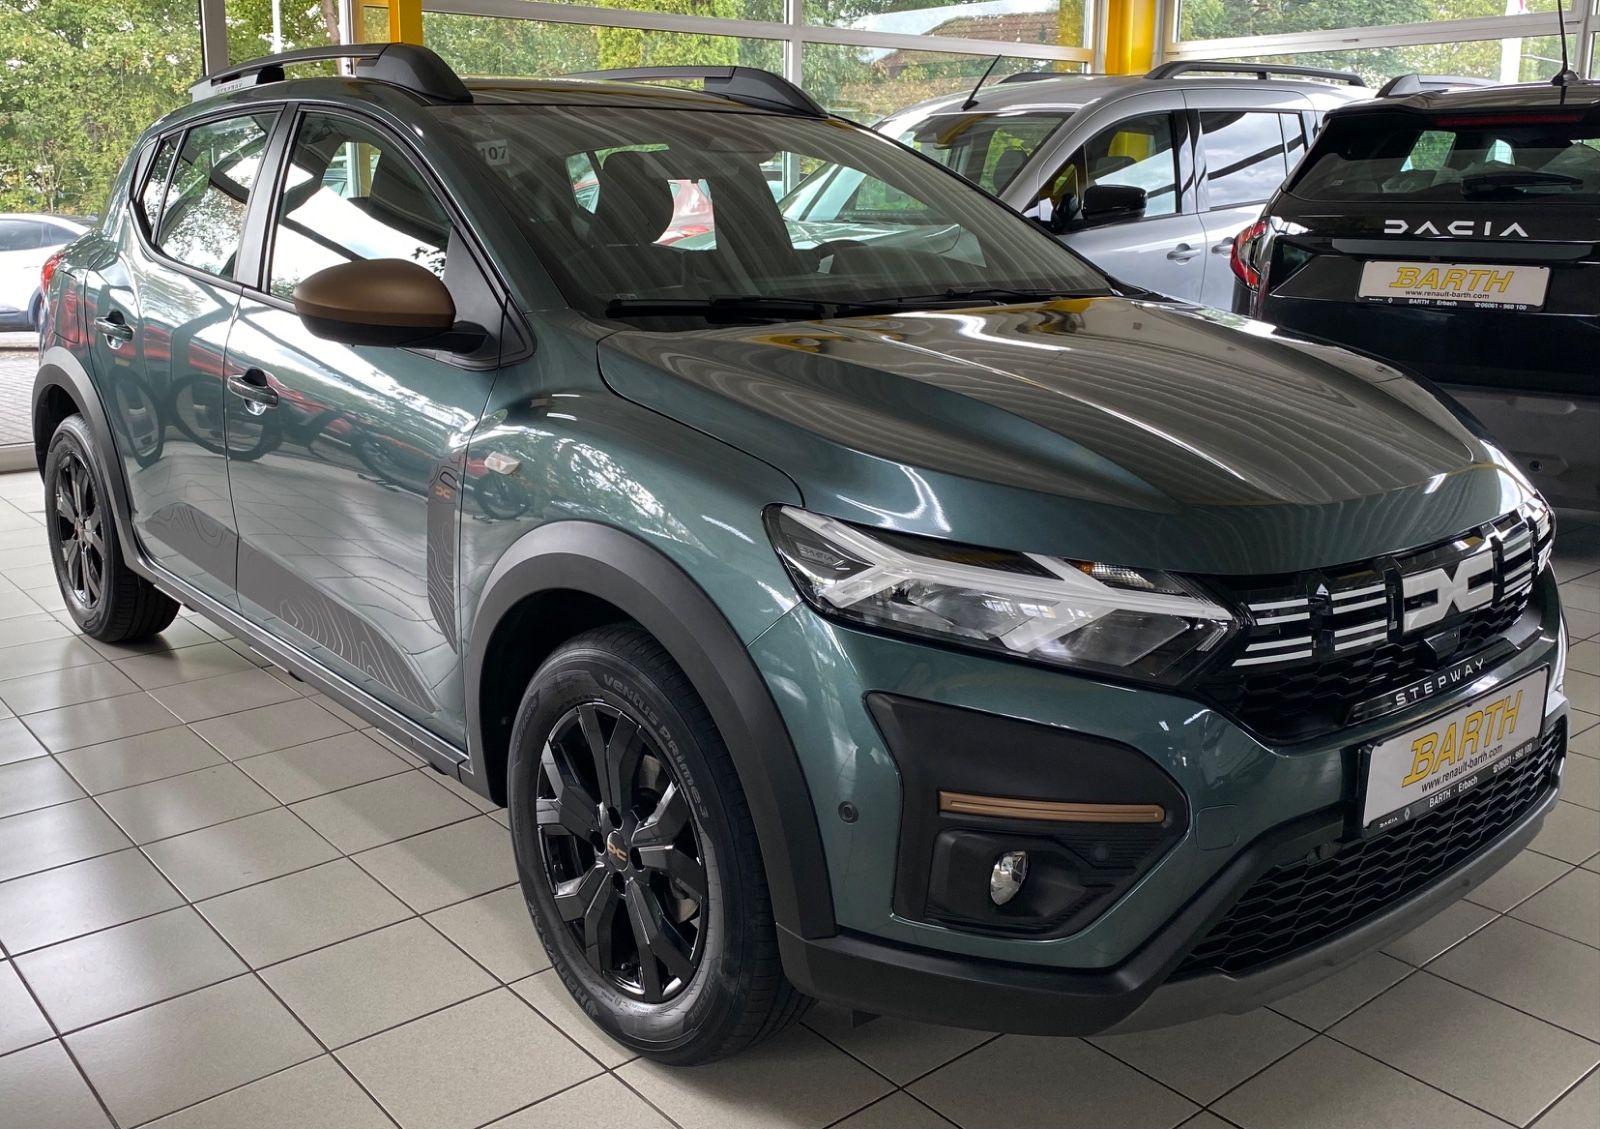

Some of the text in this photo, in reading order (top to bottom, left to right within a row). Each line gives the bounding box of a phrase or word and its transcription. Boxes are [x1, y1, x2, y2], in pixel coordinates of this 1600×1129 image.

[1384, 219, 1529, 238] DACIA
[1389, 266, 1514, 293] BARTH
[1405, 290, 1490, 300] www.renault-barth.com
[1395, 658, 1485, 706] STEPWAY
[1401, 689, 1523, 788] BARTH
[1421, 744, 1503, 793] www.renault-barth.com
[1429, 775, 1478, 808] BARTH Erbach
